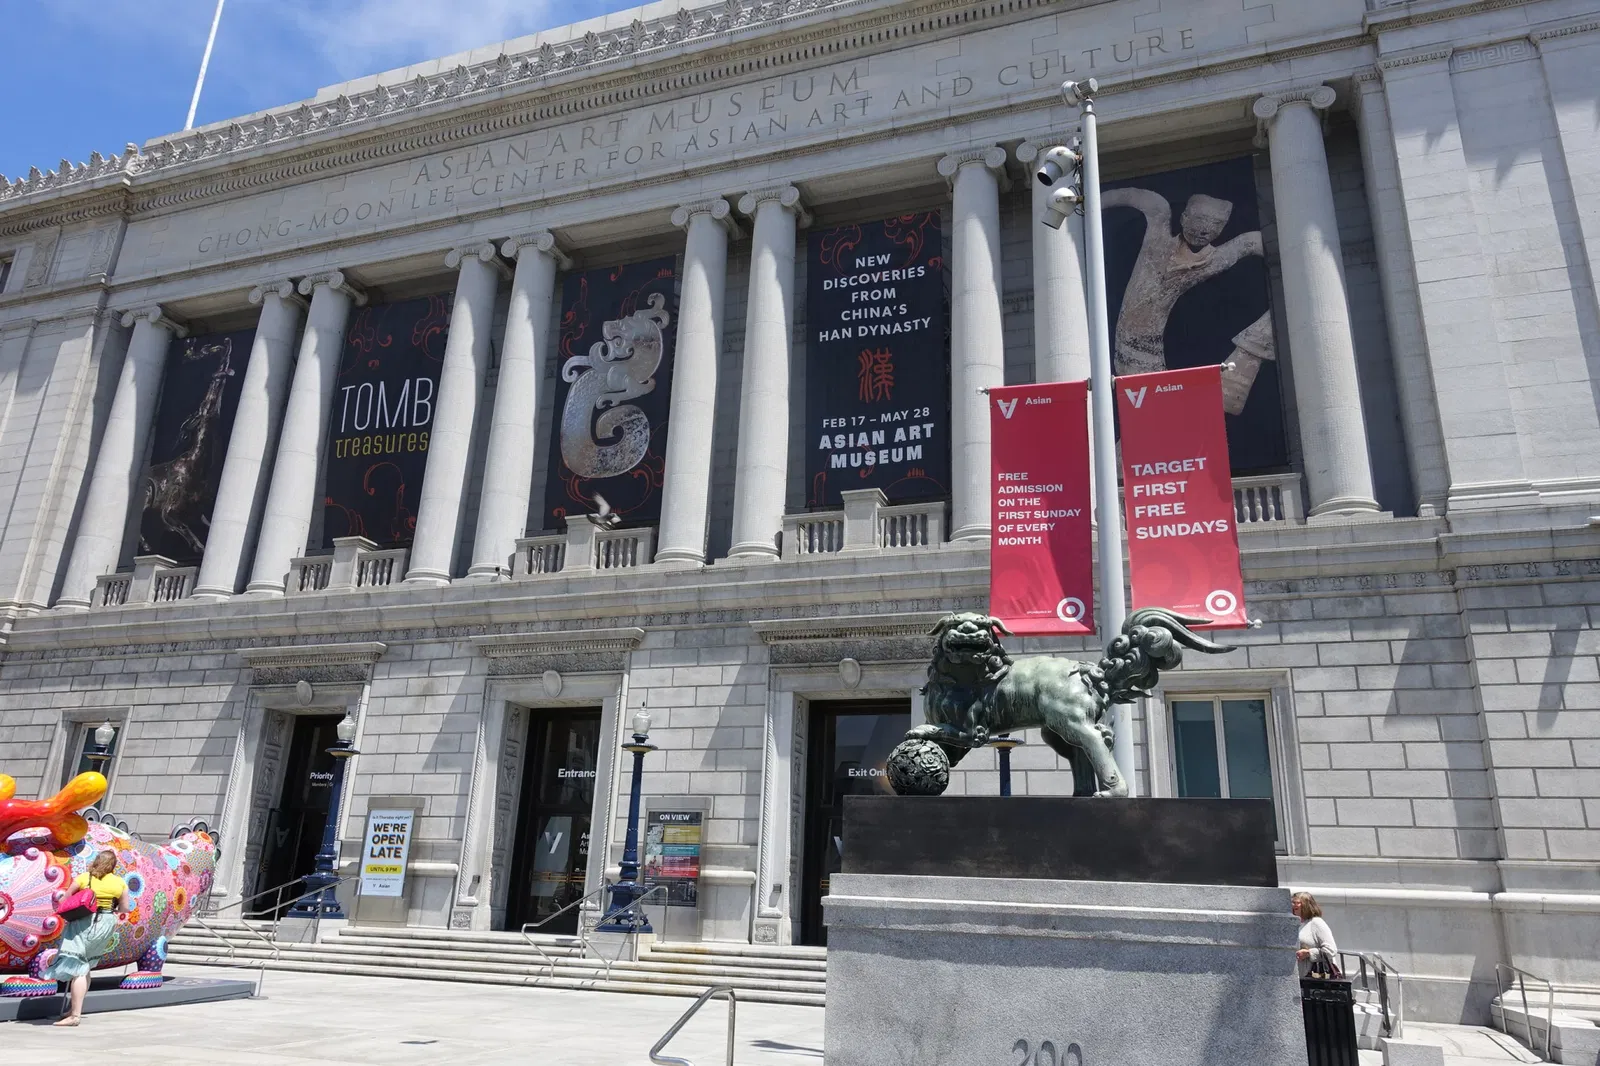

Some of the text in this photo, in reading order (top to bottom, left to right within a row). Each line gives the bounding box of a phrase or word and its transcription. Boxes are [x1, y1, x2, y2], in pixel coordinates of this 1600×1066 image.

[412, 67, 862, 186] ASIAN ART MUSEUM
[197, 28, 1195, 254] CHONG-MOON LEE CENTER FOR ASIAN ART AND CULTURE
[855, 253, 891, 268] NEW
[823, 266, 925, 290] DISCOVERIES
[851, 287, 896, 302] FROM
[841, 304, 907, 321] CHINA'S
[819, 317, 931, 342] HAN DYNASTY
[1155, 384, 1184, 393] Asian
[341, 377, 433, 433] TOMB
[1025, 397, 1052, 405] Asian
[823, 418, 846, 428] FEB
[851, 416, 866, 426] 17
[881, 410, 909, 423] MAY
[913, 407, 930, 418] 28
[819, 423, 935, 449] ASIAN ART
[336, 432, 429, 458] treasures
[831, 445, 923, 468] MUSEUM
[1131, 457, 1207, 477] TARGET
[998, 472, 1029, 481] FREE
[998, 484, 1063, 494] ADMISSION
[1133, 481, 1188, 498] FIRST
[998, 498, 1041, 507] ON THE
[1135, 502, 1186, 518] FREE
[998, 509, 1081, 519] FIRST SUNDAY
[998, 523, 1056, 533] OF EVERY
[1136, 519, 1229, 540] SUNDAYS
[998, 537, 1042, 546] MONTH
[309, 772, 334, 781] Priority
[557, 768, 596, 778] Entranc
[848, 768, 868, 777] Exit
[371, 834, 405, 845] OPEN
[370, 847, 402, 859] LATE
